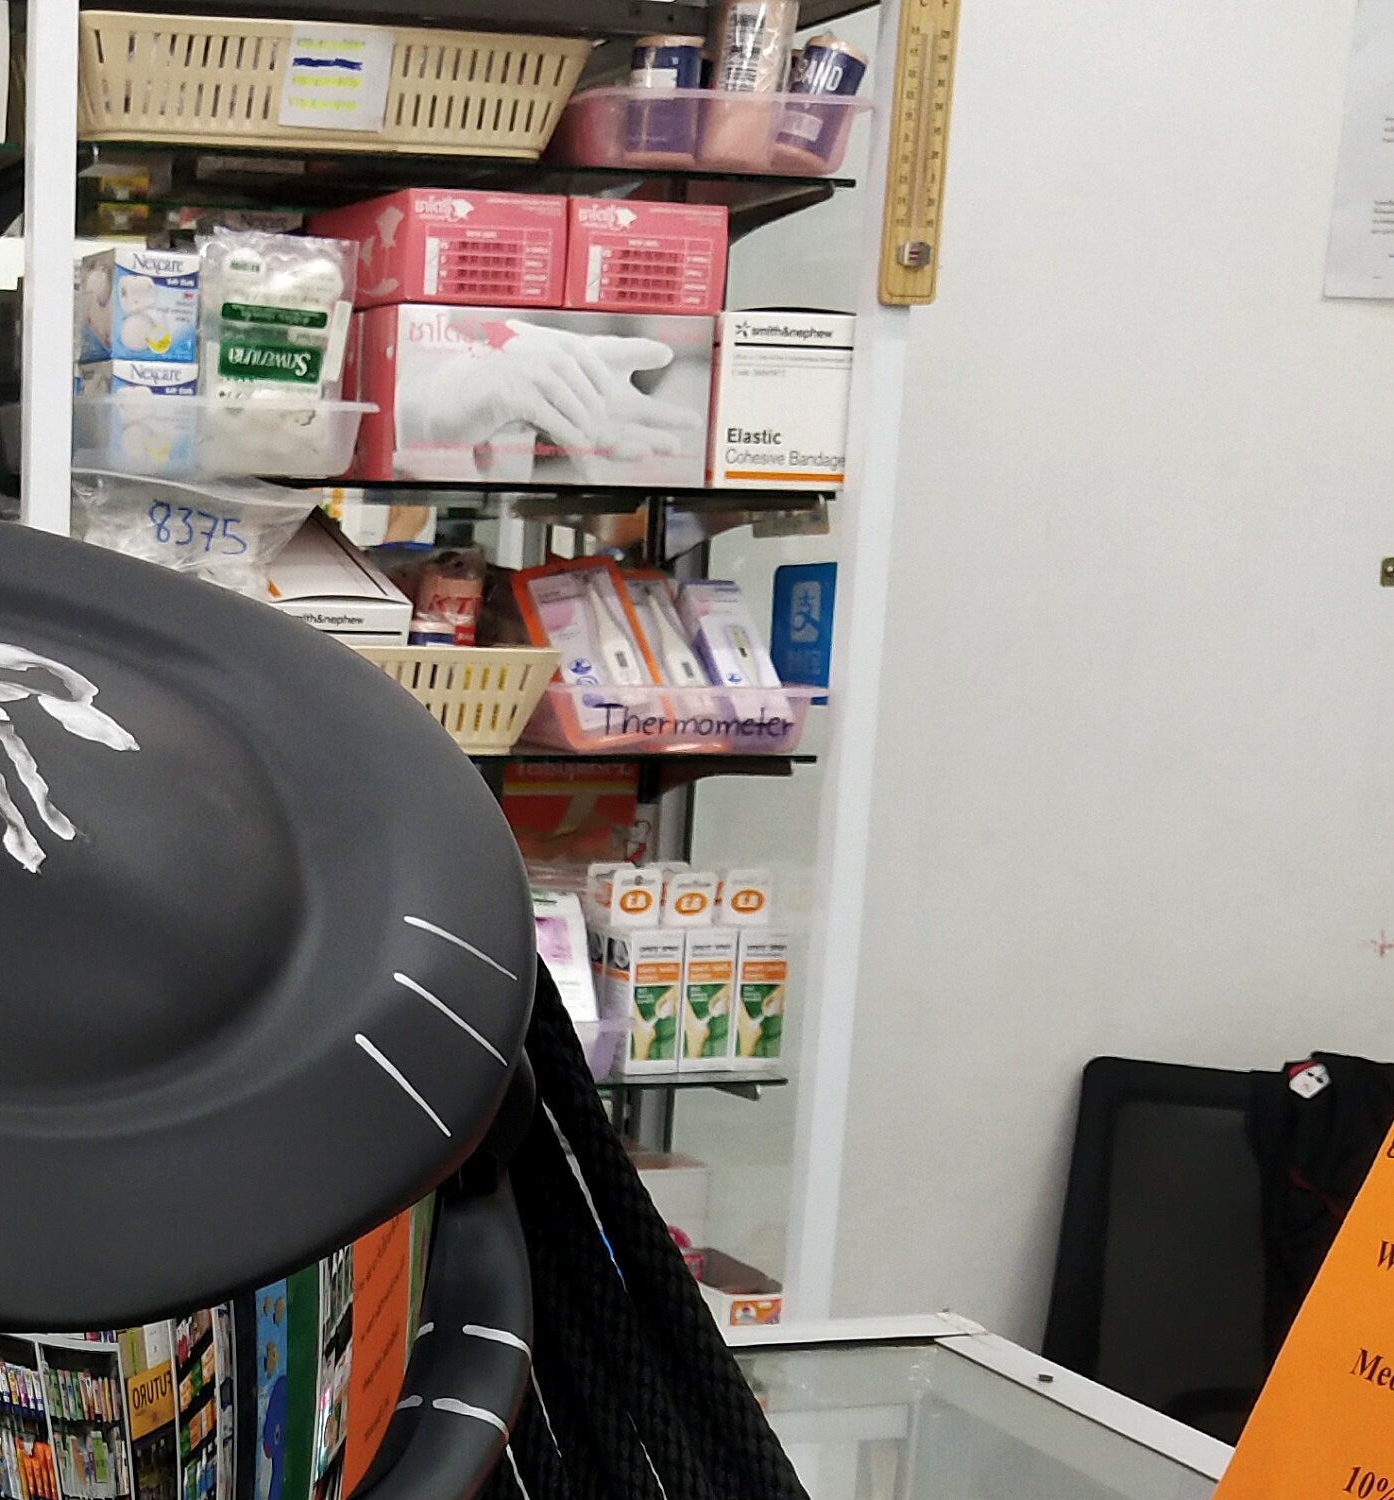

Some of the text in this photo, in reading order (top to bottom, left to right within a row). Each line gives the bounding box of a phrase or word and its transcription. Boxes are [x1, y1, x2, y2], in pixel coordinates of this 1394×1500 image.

[132, 253, 184, 273] Nexcare
[752, 324, 833, 339] smith&nephew
[131, 365, 182, 383] Nexcare
[727, 427, 782, 446] Elastic
[725, 448, 847, 472] Cohesive Bandage
[149, 499, 248, 556] 8375
[592, 702, 795, 738] Thermometer
